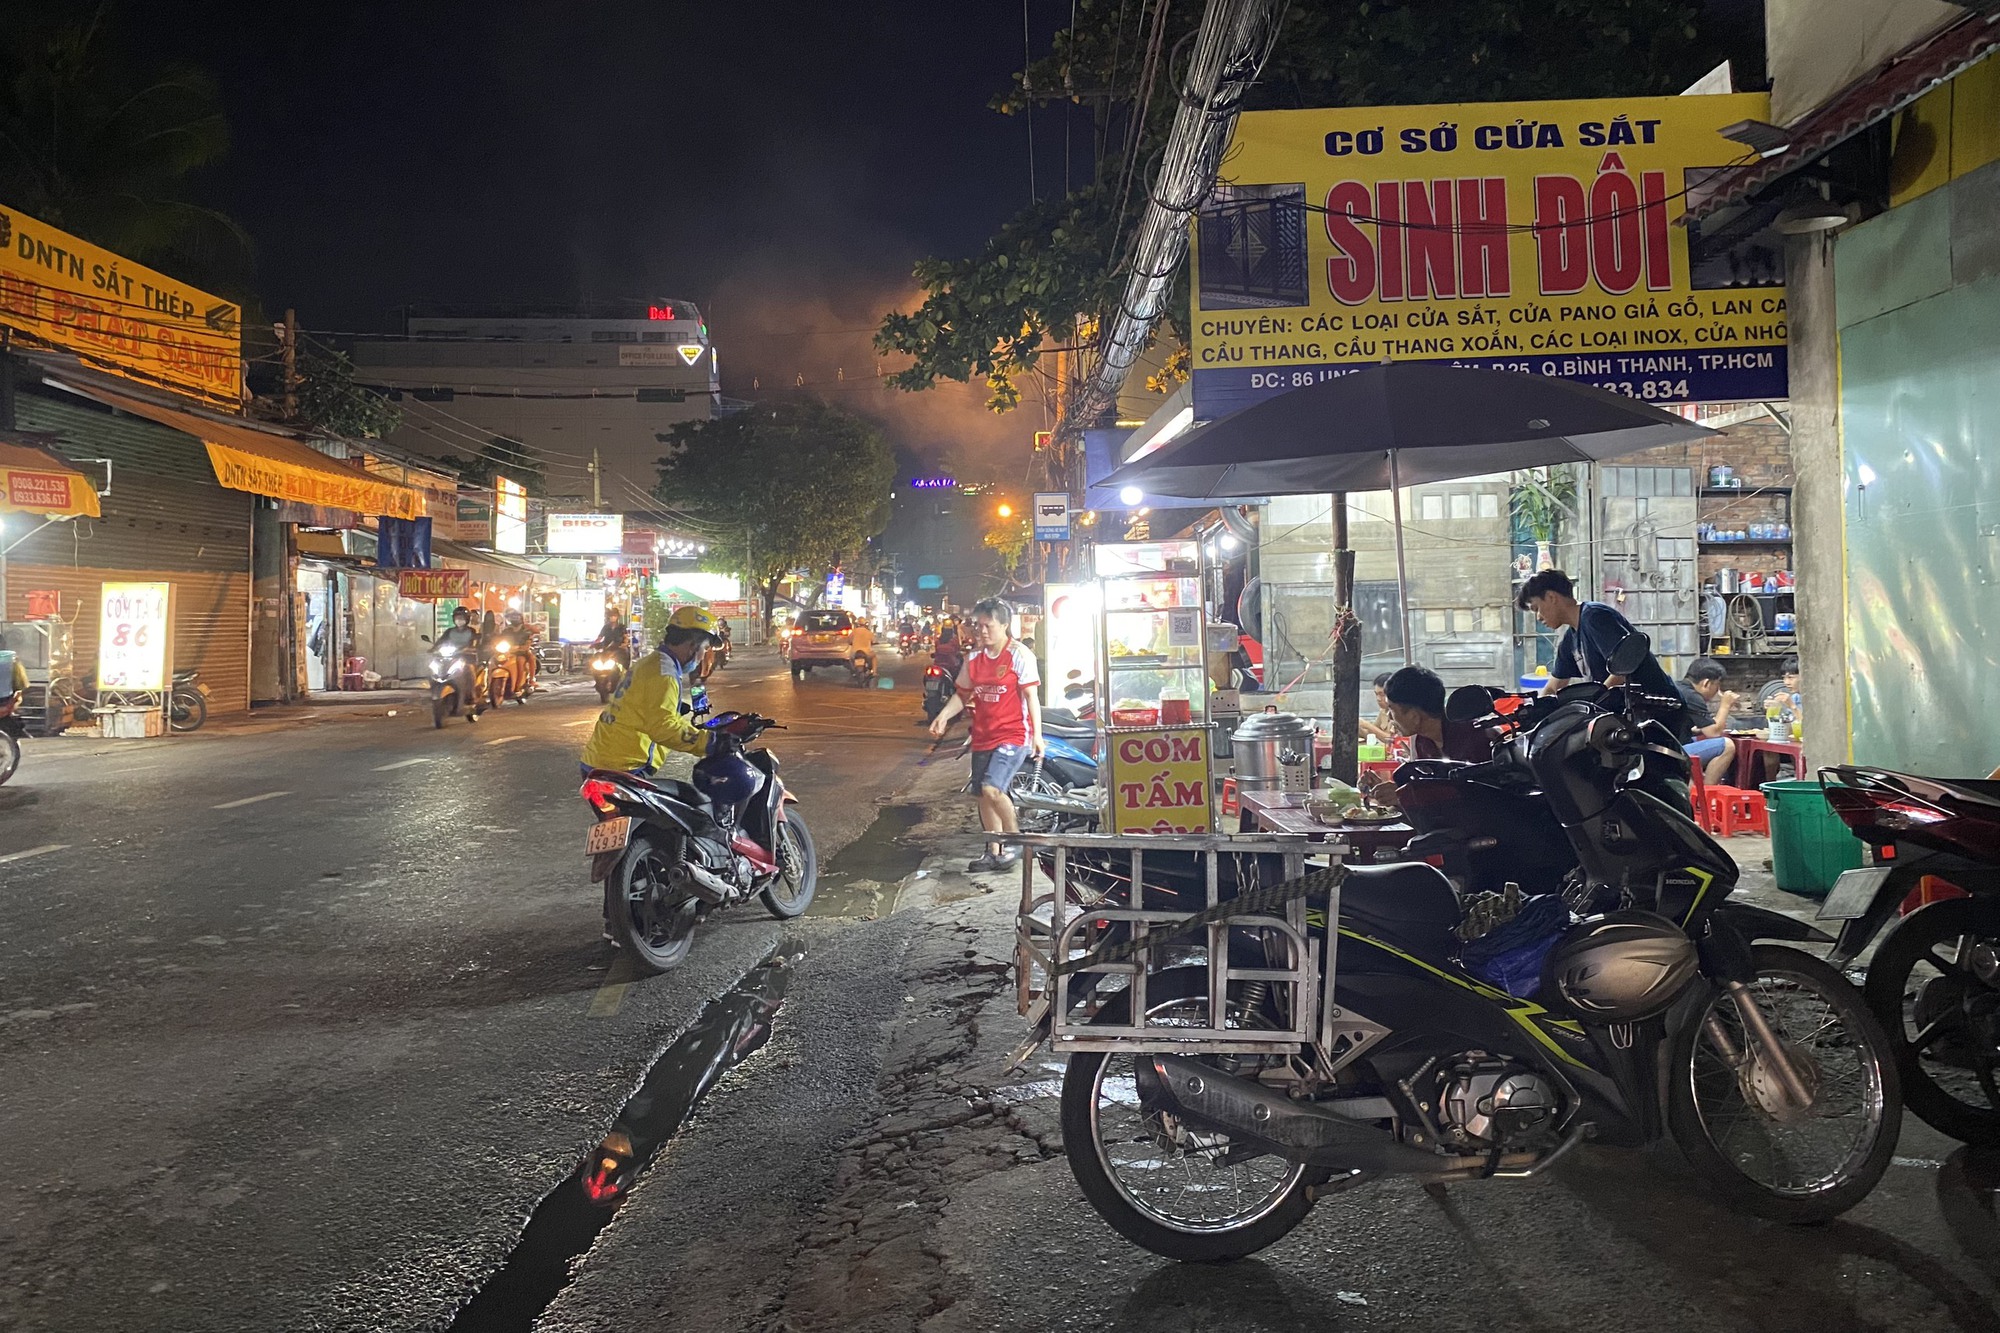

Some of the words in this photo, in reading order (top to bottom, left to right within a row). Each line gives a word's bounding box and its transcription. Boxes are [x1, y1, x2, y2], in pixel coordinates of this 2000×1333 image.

[1324, 126, 1385, 156] CƠ
[1400, 121, 1458, 153] SỞ
[1474, 118, 1564, 150] CỬA
[1578, 114, 1662, 147] SẮT
[1325, 175, 1512, 306] SINH
[1533, 151, 1672, 297] ĐÔI
[18, 232, 84, 281] DNTN
[92, 261, 134, 300] SẮT
[141, 283, 195, 321] THÉP
[648, 305, 675, 320] B&L
[1201, 315, 1292, 337] CHUYÊN:
[1301, 313, 1343, 332] CÁC
[1352, 313, 1398, 333] LOẠI
[1406, 307, 1449, 328] CỬA
[1457, 304, 1500, 326] SẮT,
[1509, 303, 1552, 323] CỬA
[1560, 304, 1616, 321] PANO
[1624, 298, 1660, 319] GIẢ
[1667, 295, 1703, 318] GỖ,
[1712, 300, 1751, 316] LAN
[156, 327, 234, 388] SANG
[1202, 341, 1243, 363] CẦU
[1250, 342, 1328, 361] THANG,
[1334, 336, 1376, 357] CẦU
[1382, 337, 1454, 355] THANG
[1461, 329, 1524, 352] XOẮN,
[1530, 330, 1573, 349] CÁC
[1580, 330, 1627, 350] LOẠI
[1634, 328, 1688, 346] INOX,
[1695, 321, 1738, 342] CỬA
[1250, 372, 1285, 389] ĐC:
[1291, 371, 1314, 387] 86
[1542, 356, 1611, 377] Q.BÌNH
[1617, 355, 1693, 376] THẠNH,
[1699, 352, 1773, 370] TP.HCM
[224, 463, 246, 485] DNTN
[286, 473, 319, 499] KIM
[112, 623, 148, 647] 86
[1120, 733, 1202, 764] CƠM
[1120, 771, 1205, 808] TẤM
